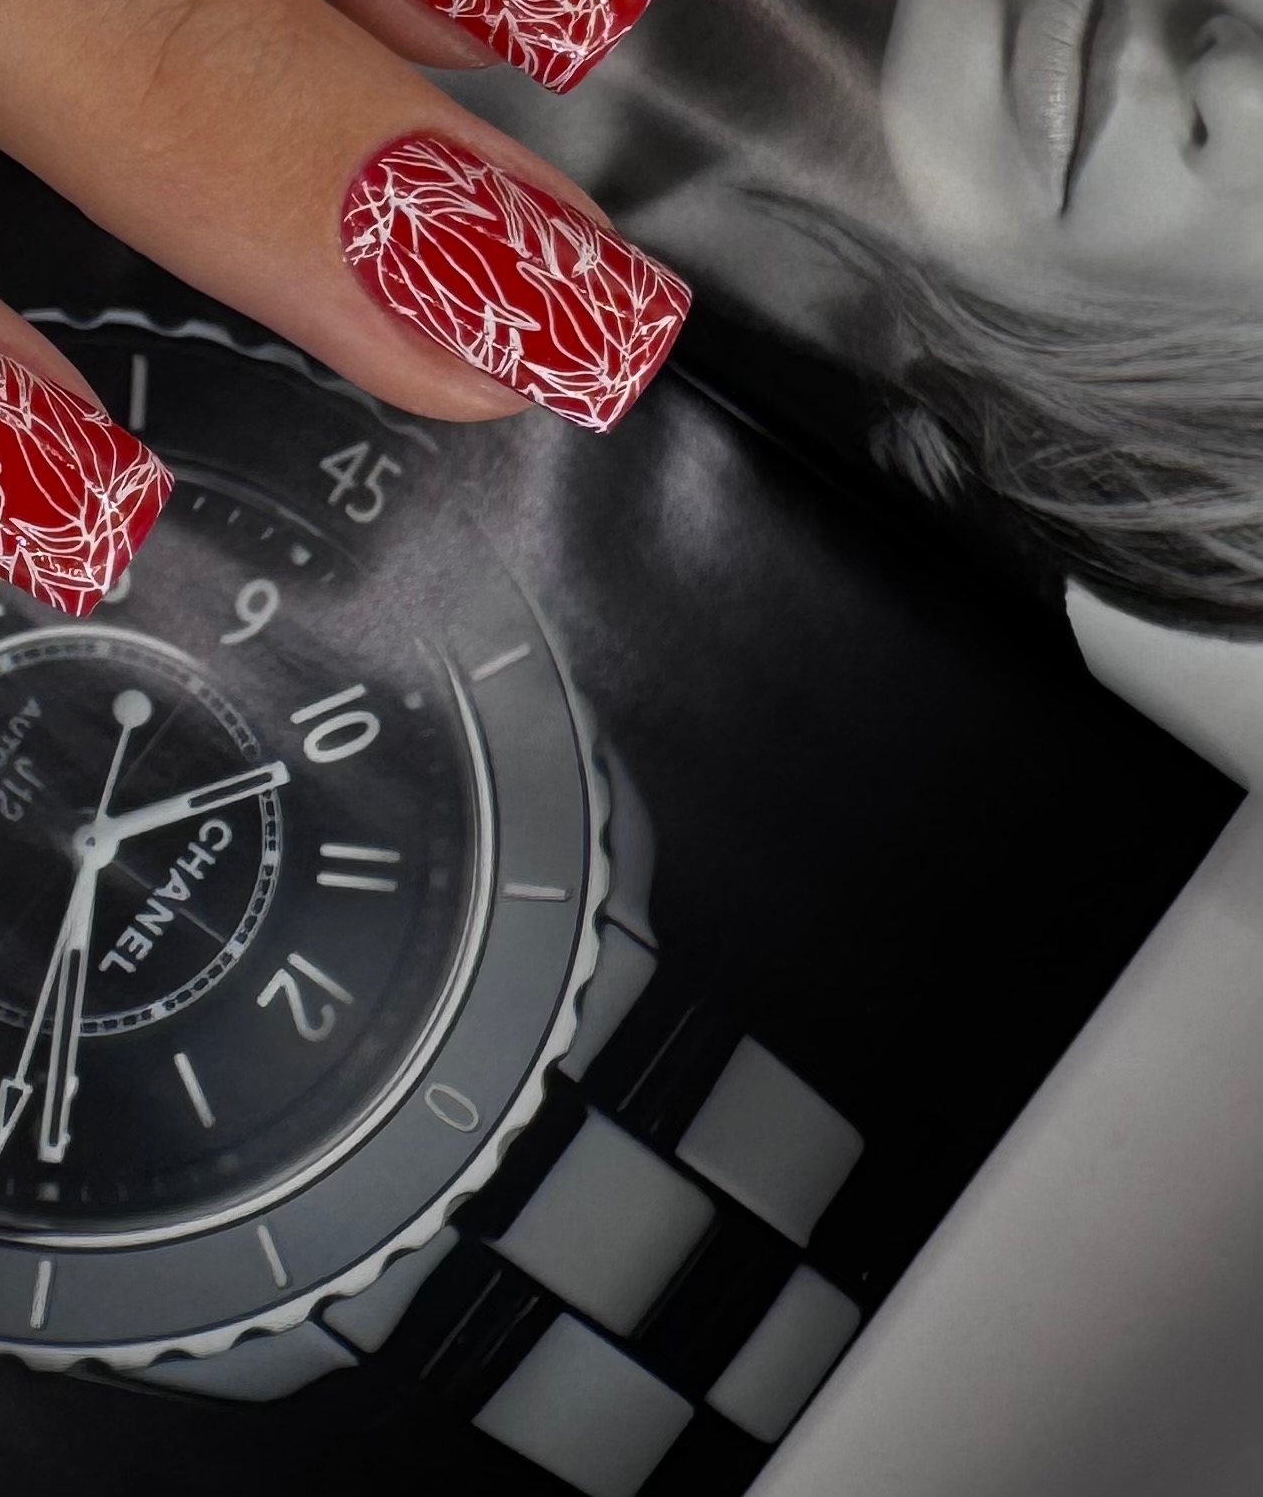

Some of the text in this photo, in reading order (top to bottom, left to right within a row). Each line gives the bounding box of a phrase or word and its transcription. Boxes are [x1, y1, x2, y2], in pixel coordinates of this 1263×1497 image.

[318, 441, 402, 524] 45
[219, 578, 280, 646] 9
[289, 683, 381, 764] 10
[98, 817, 233, 974] CHANEL
[256, 952, 354, 1042] 12
[423, 1082, 481, 1134] 0
